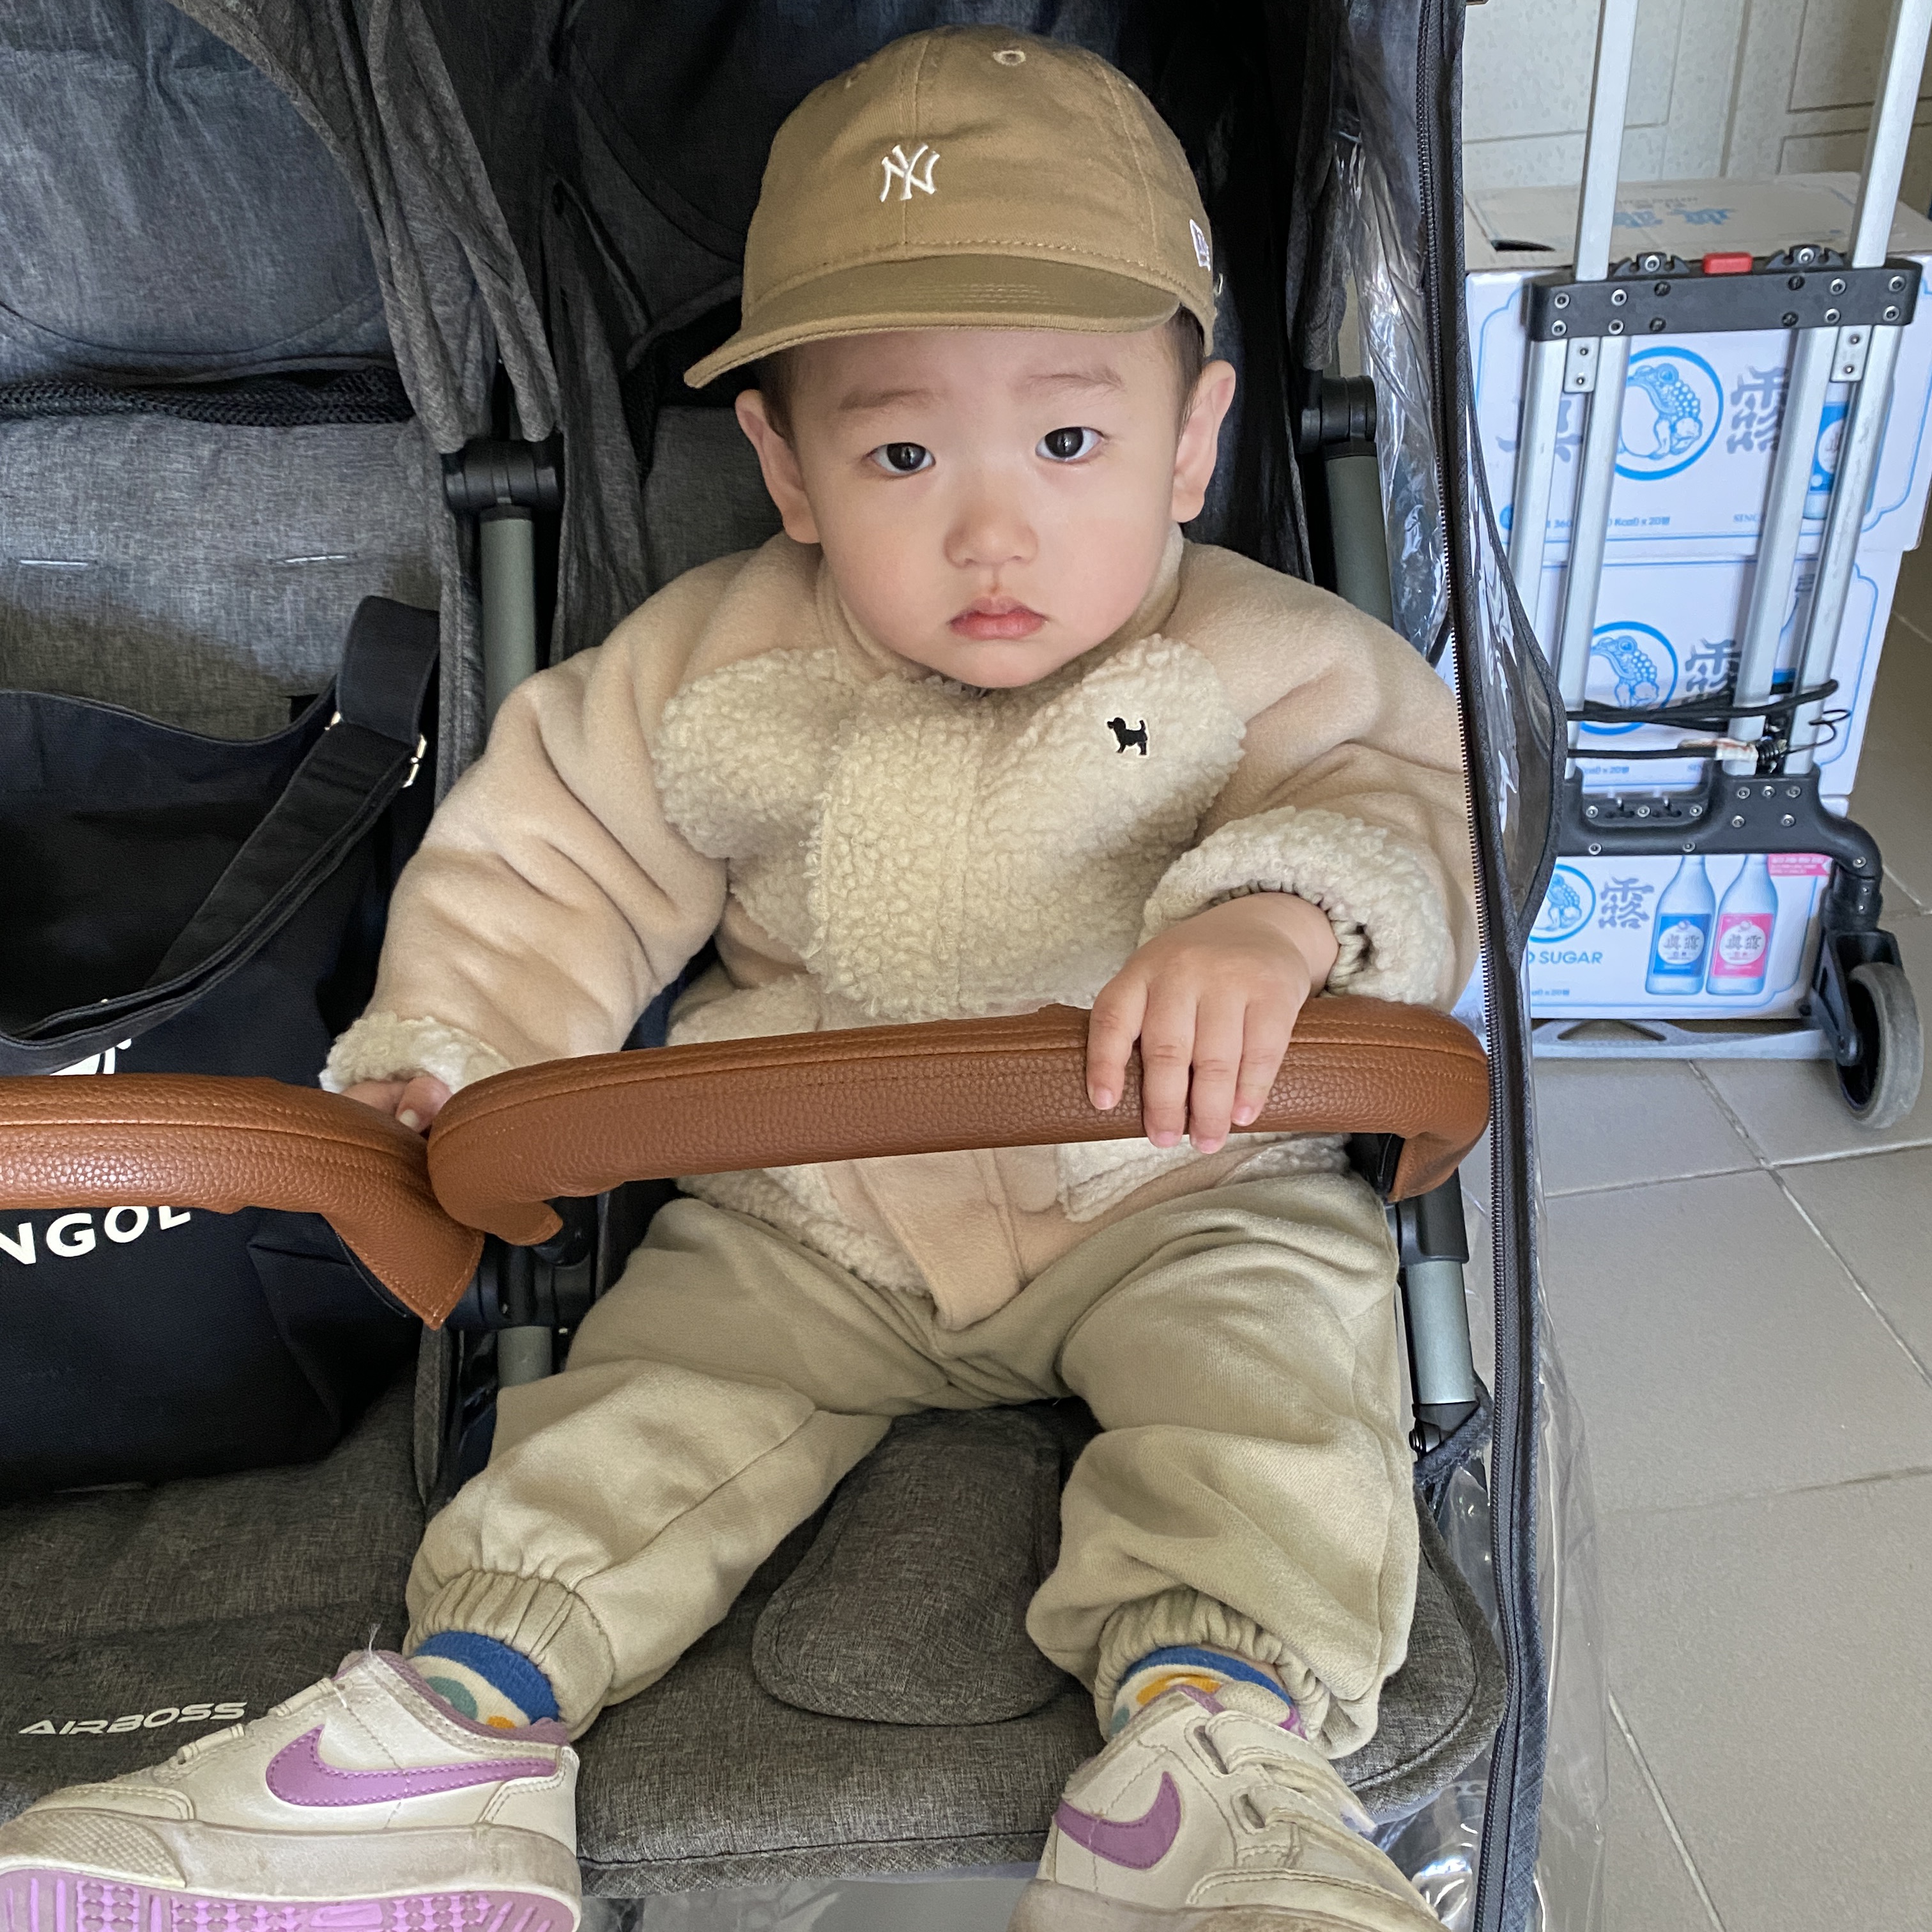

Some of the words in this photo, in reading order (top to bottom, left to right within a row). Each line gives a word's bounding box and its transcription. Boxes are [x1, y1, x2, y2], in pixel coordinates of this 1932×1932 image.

[879, 144, 940, 203] NY
[1538, 951, 1603, 965] SUGAR
[18, 1702, 248, 1735] AIRBOSS
